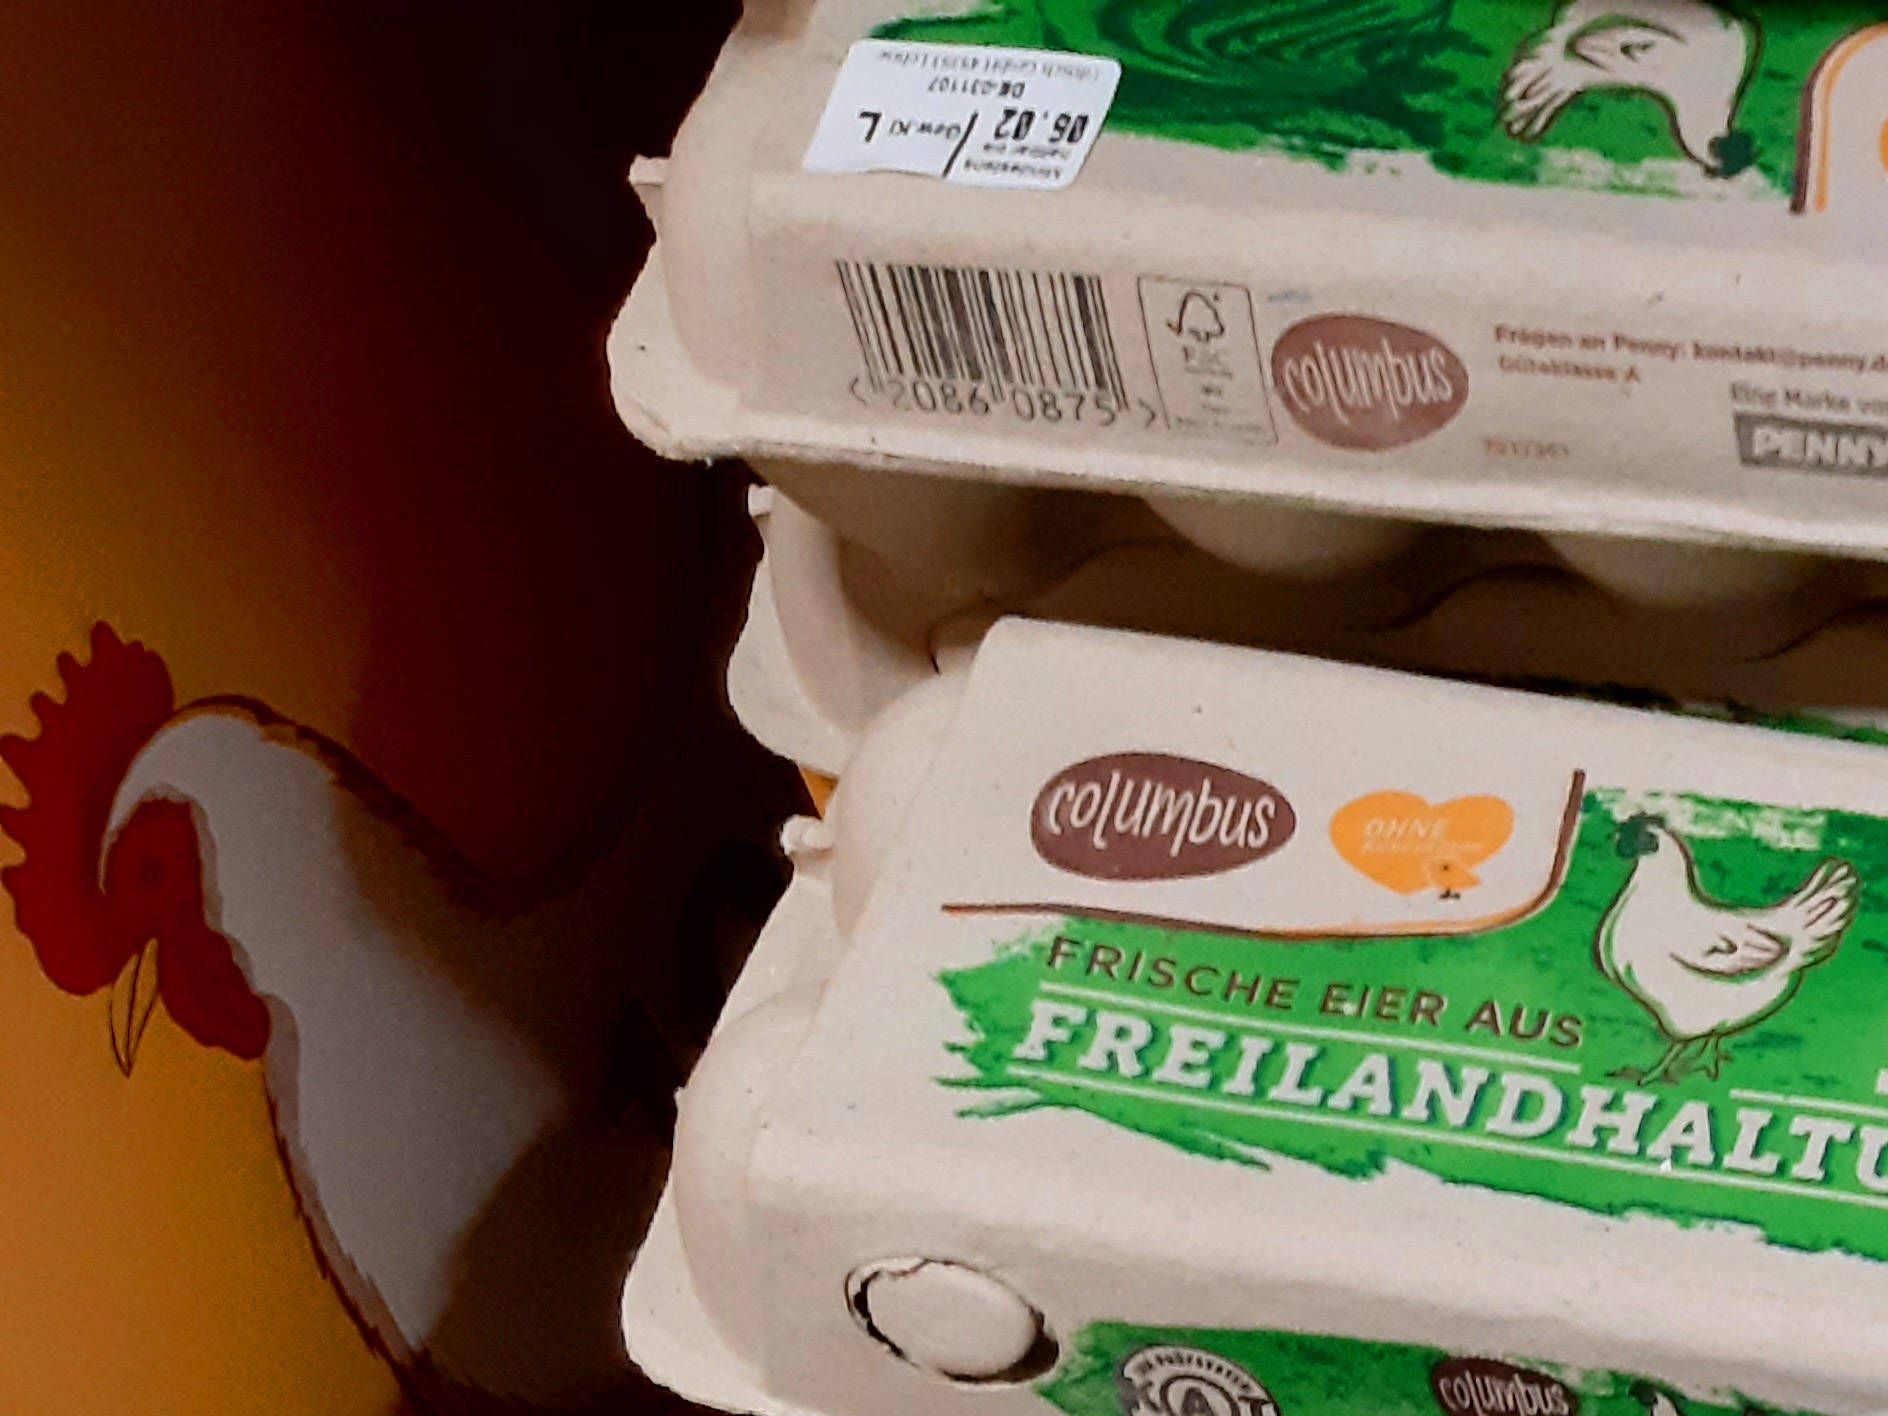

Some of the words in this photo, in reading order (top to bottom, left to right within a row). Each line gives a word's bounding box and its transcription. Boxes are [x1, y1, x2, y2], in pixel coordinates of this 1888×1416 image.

[858, 111, 883, 144] L
[1010, 386, 1118, 427] 0875
[1282, 324, 1456, 428] columbus
[1043, 771, 1278, 857] columbus
[1043, 934, 1296, 1014] FRISCHE
[1318, 981, 1447, 1026] EIER
[1462, 998, 1586, 1050] AUS
